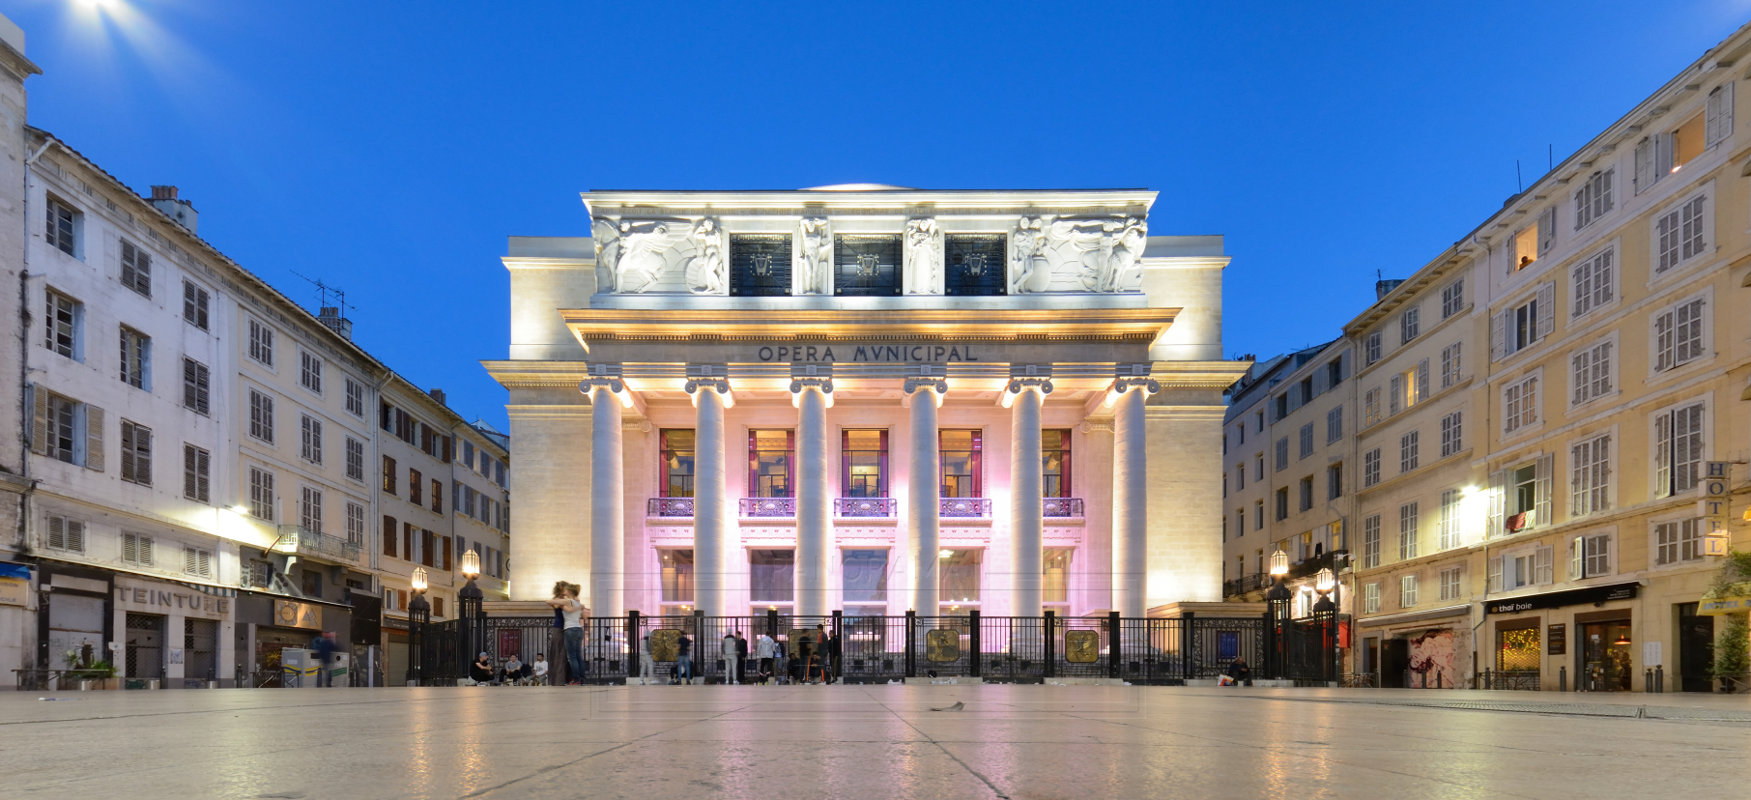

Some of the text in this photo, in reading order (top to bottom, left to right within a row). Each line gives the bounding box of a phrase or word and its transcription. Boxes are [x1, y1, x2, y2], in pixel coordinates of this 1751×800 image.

[758, 346, 978, 362] OPERA MVNICIPAL
[1709, 463, 1724, 553] HOTEL
